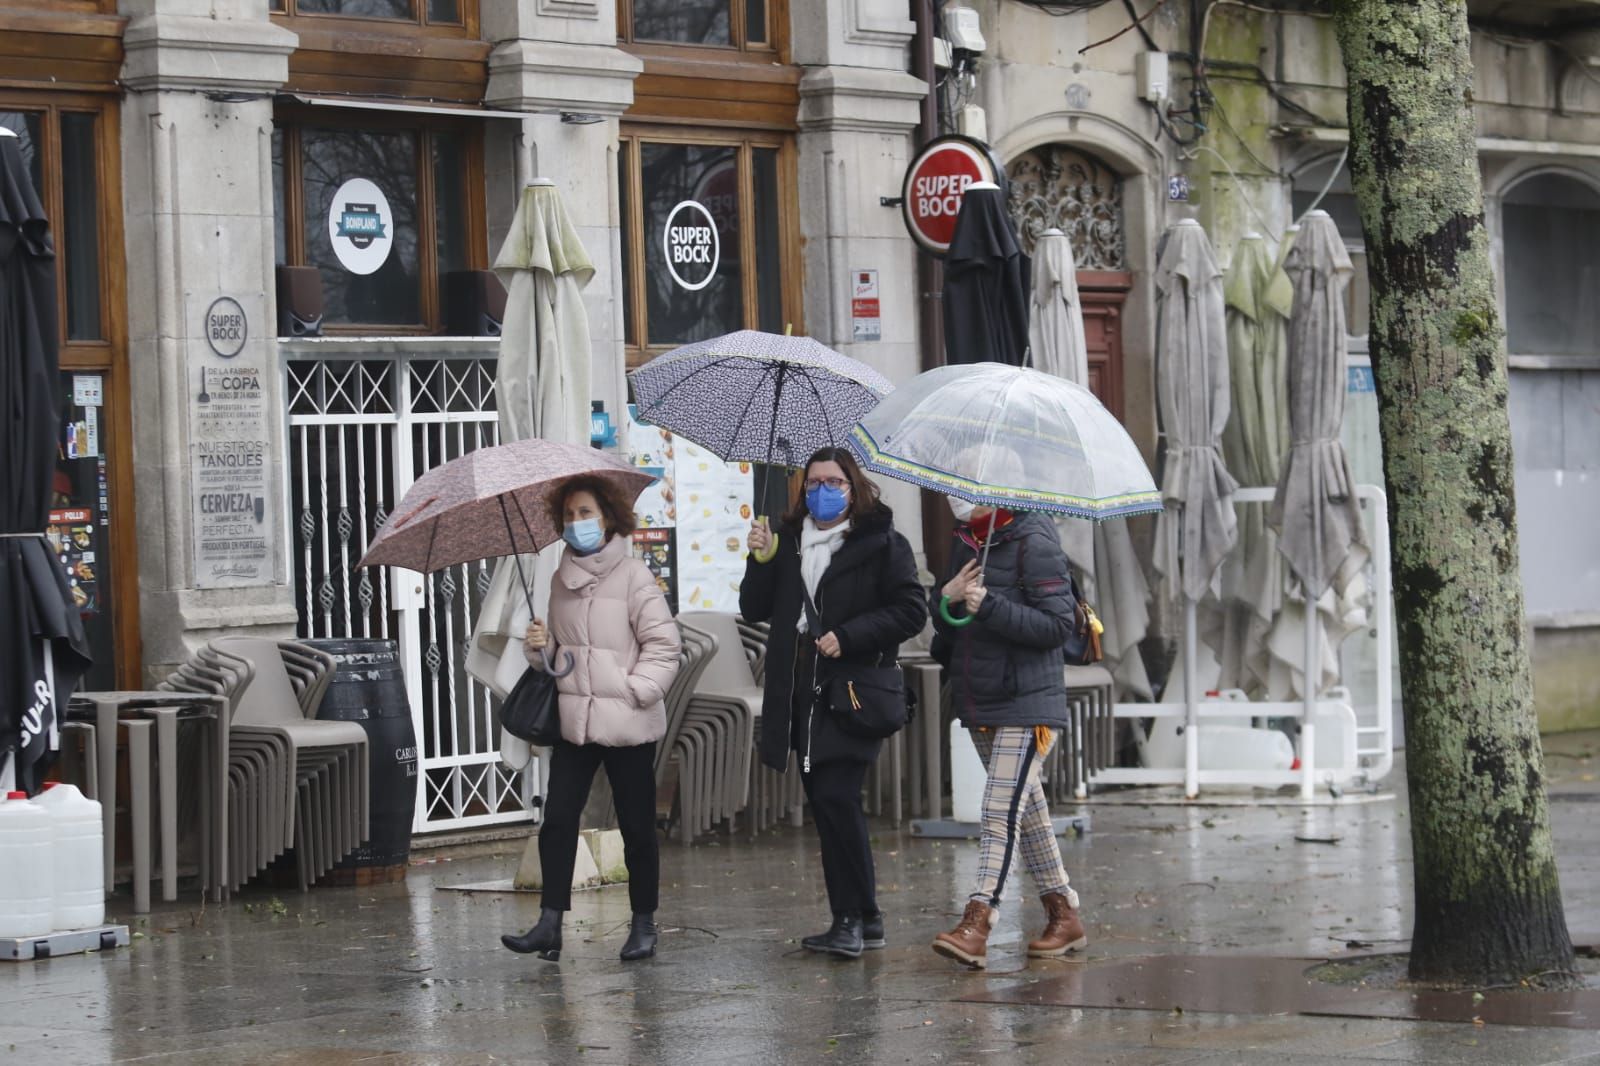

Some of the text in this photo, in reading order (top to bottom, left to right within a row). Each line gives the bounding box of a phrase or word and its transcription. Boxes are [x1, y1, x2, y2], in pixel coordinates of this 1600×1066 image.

[916, 174, 973, 197] SUPER
[670, 226, 712, 245] SUPER
[673, 245, 711, 263] BOCK
[210, 314, 241, 327] SUPER
[212, 327, 241, 340] BOCK
[222, 377, 260, 389] COPA
[199, 440, 263, 454] NUESTROS
[200, 453, 263, 467] TANQUES
[201, 493, 253, 514] CERVEZA
[203, 525, 254, 535] PERFECTA
